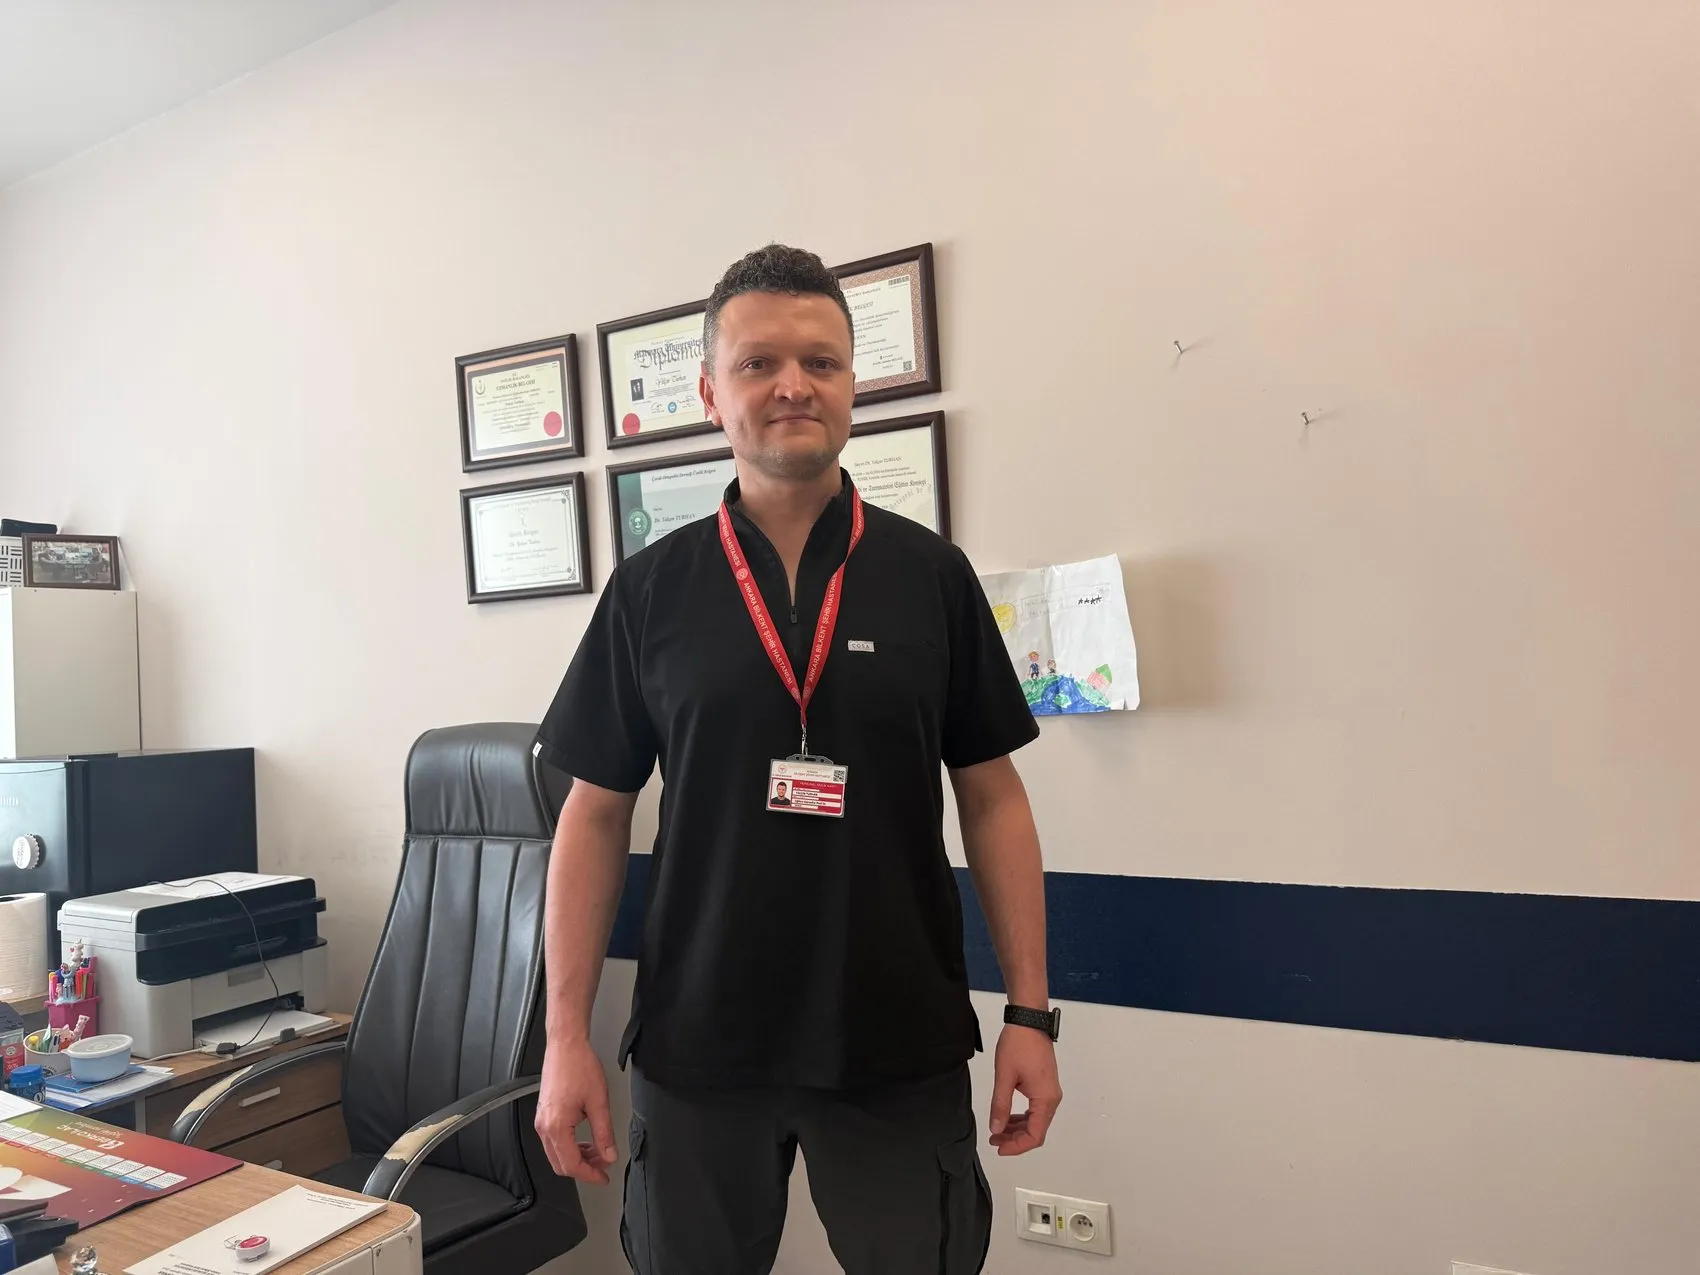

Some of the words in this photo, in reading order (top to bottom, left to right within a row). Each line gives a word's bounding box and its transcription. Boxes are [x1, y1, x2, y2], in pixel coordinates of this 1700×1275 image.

[743, 582, 757, 606] ANKARA
[753, 604, 769, 631] BİLKENT
[762, 630, 777, 650] ŞEHİR
[808, 653, 821, 682] ANKARA
